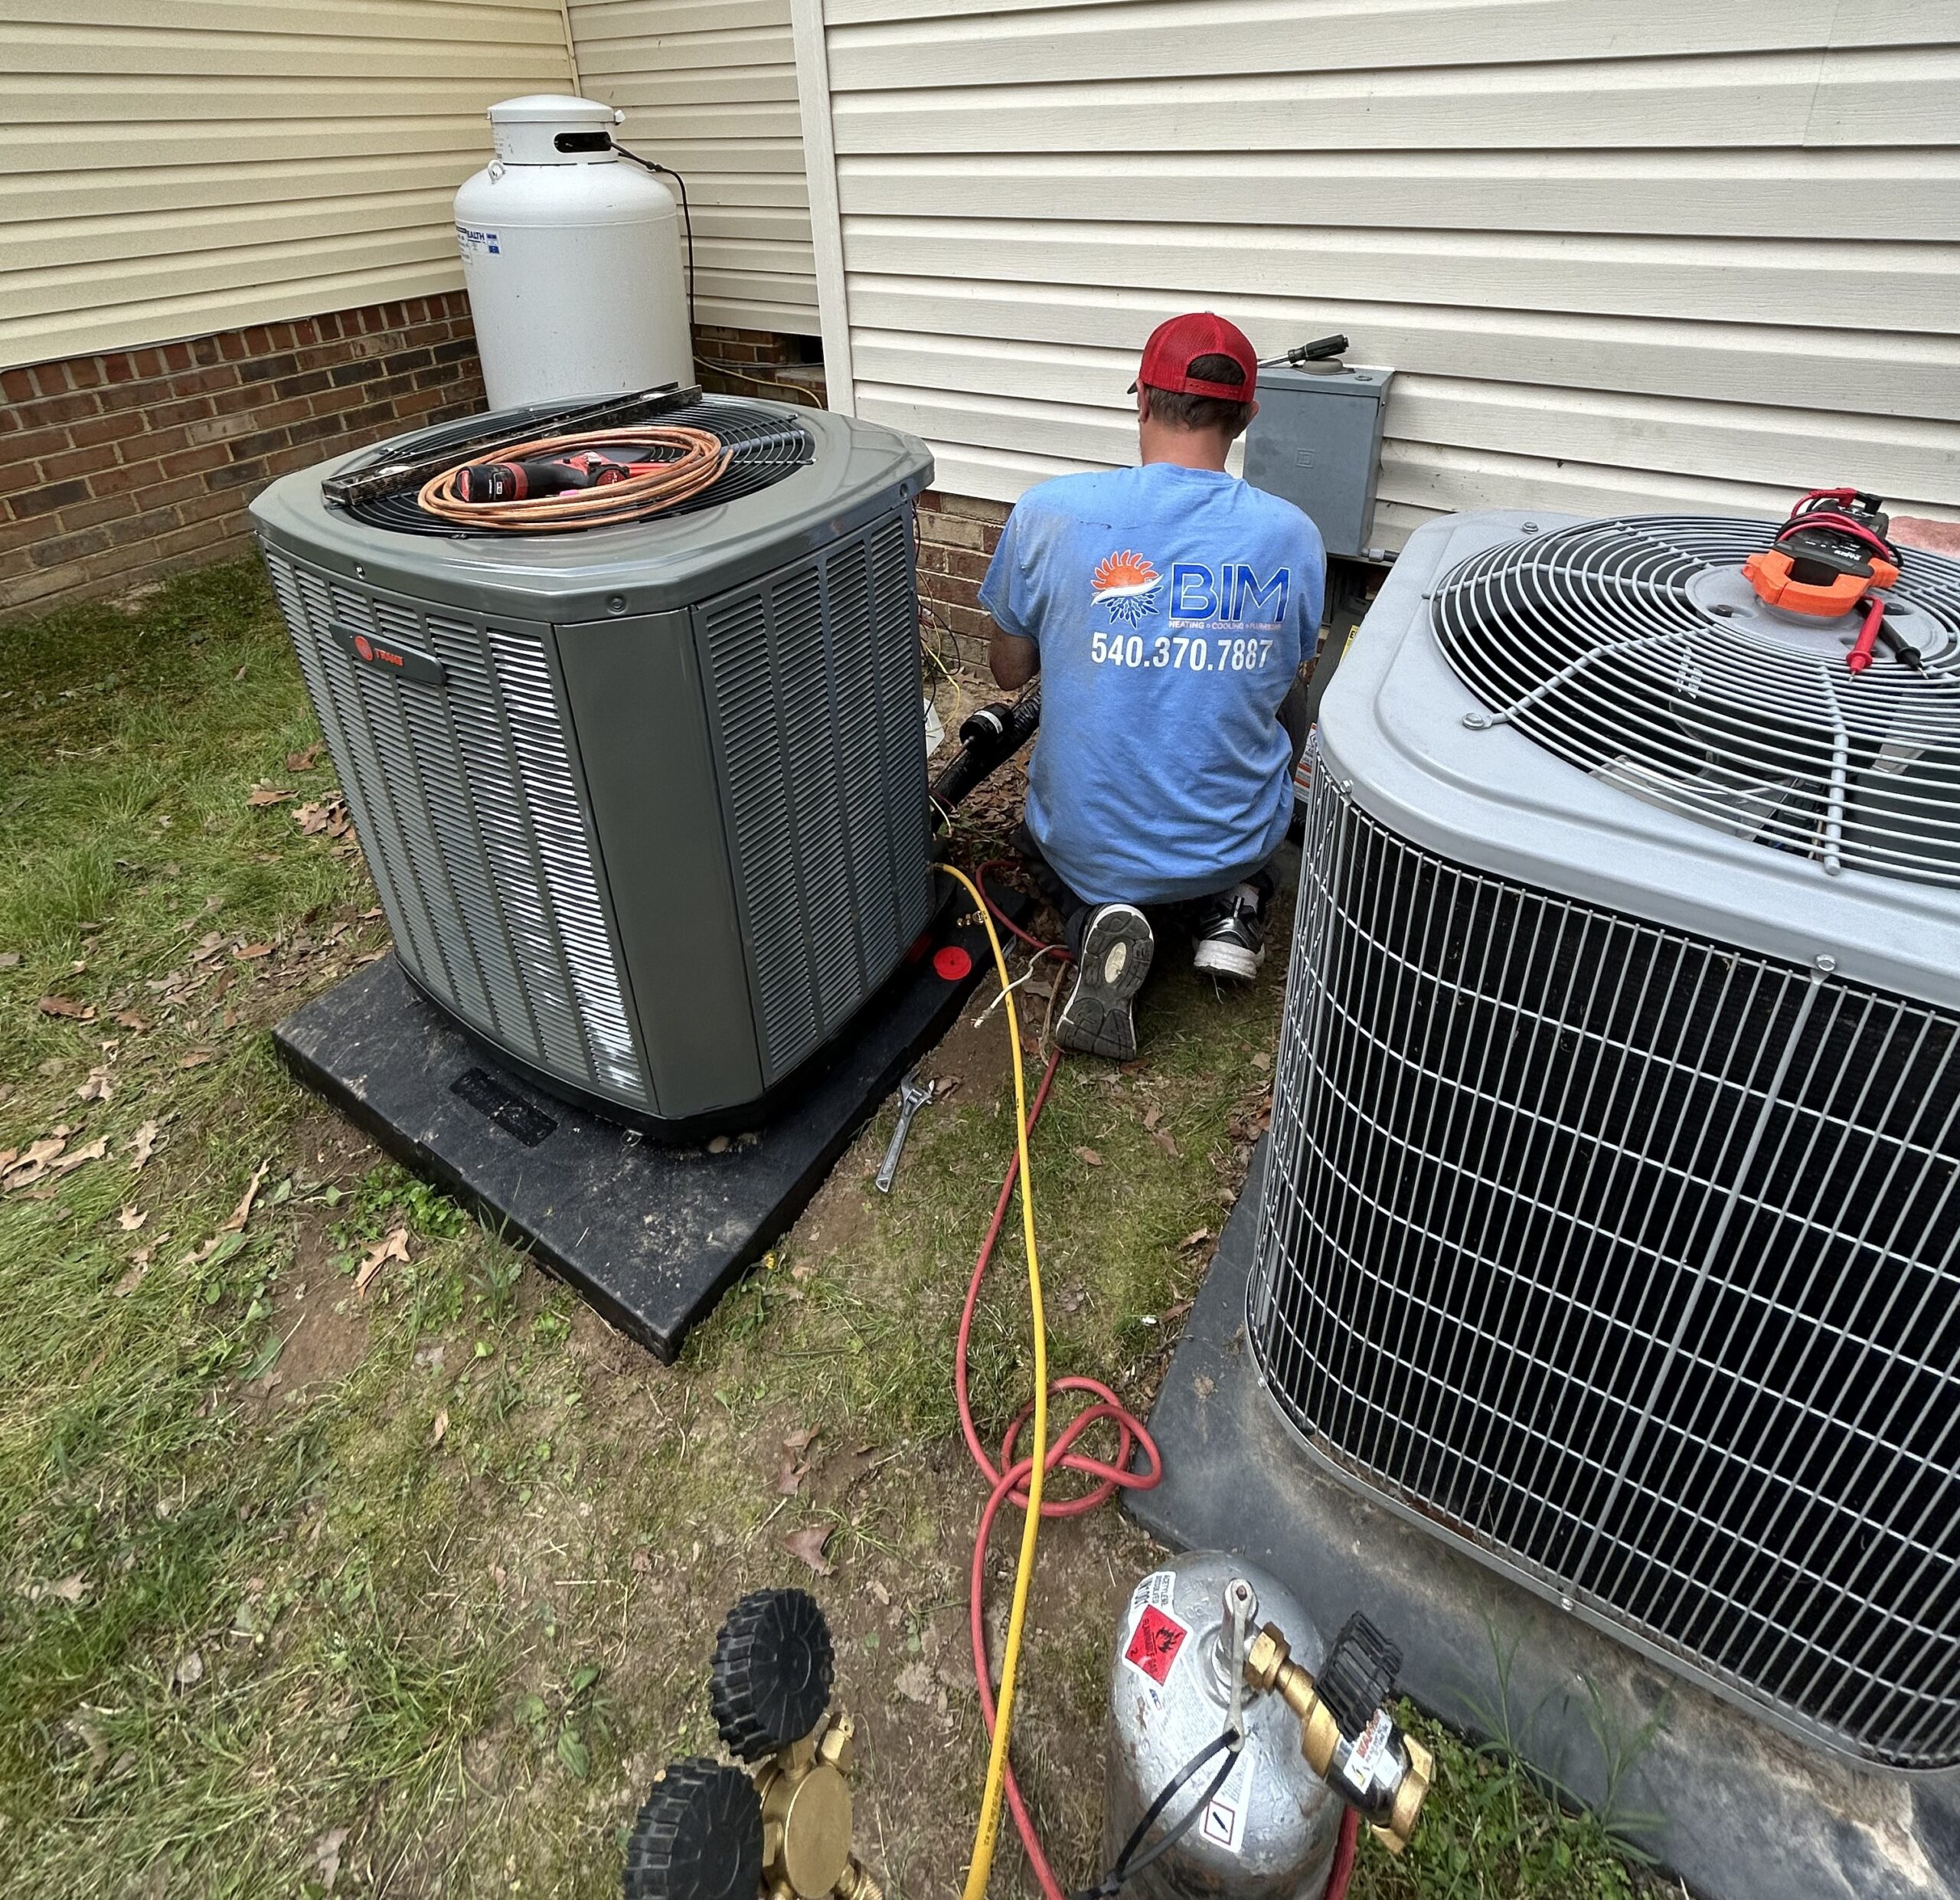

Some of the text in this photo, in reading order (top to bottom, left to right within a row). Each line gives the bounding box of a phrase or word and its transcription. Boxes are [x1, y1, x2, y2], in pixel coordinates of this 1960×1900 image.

[1168, 562, 1291, 623] BIM
[1168, 620, 1204, 630] HEATING
[1211, 621, 1244, 630] COOLING
[1090, 631, 1273, 671] 540.370.7887
[1130, 1647, 1138, 1657] 2
